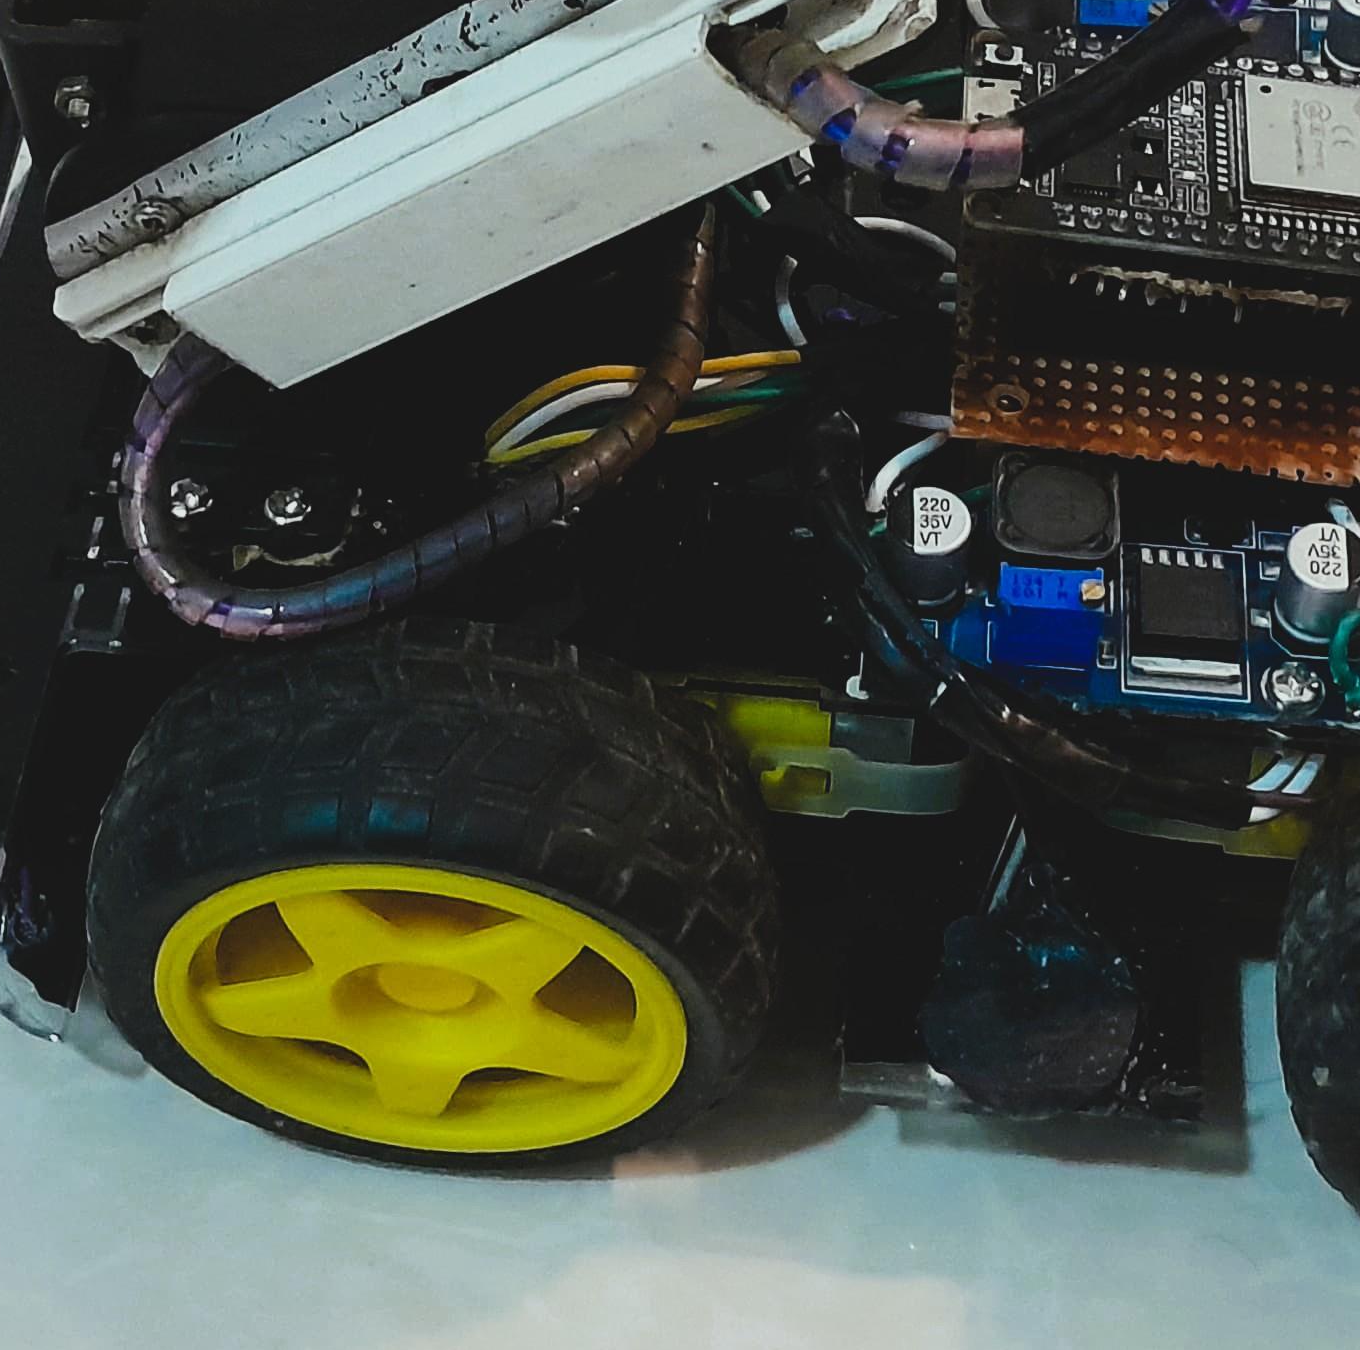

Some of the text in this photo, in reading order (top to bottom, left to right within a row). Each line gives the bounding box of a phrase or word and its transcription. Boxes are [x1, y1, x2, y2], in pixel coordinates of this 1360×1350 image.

[919, 497, 951, 512] 220
[920, 531, 942, 547] VT
[1319, 526, 1341, 542] VT
[1307, 543, 1342, 559] 35V
[1310, 560, 1343, 578] 220
